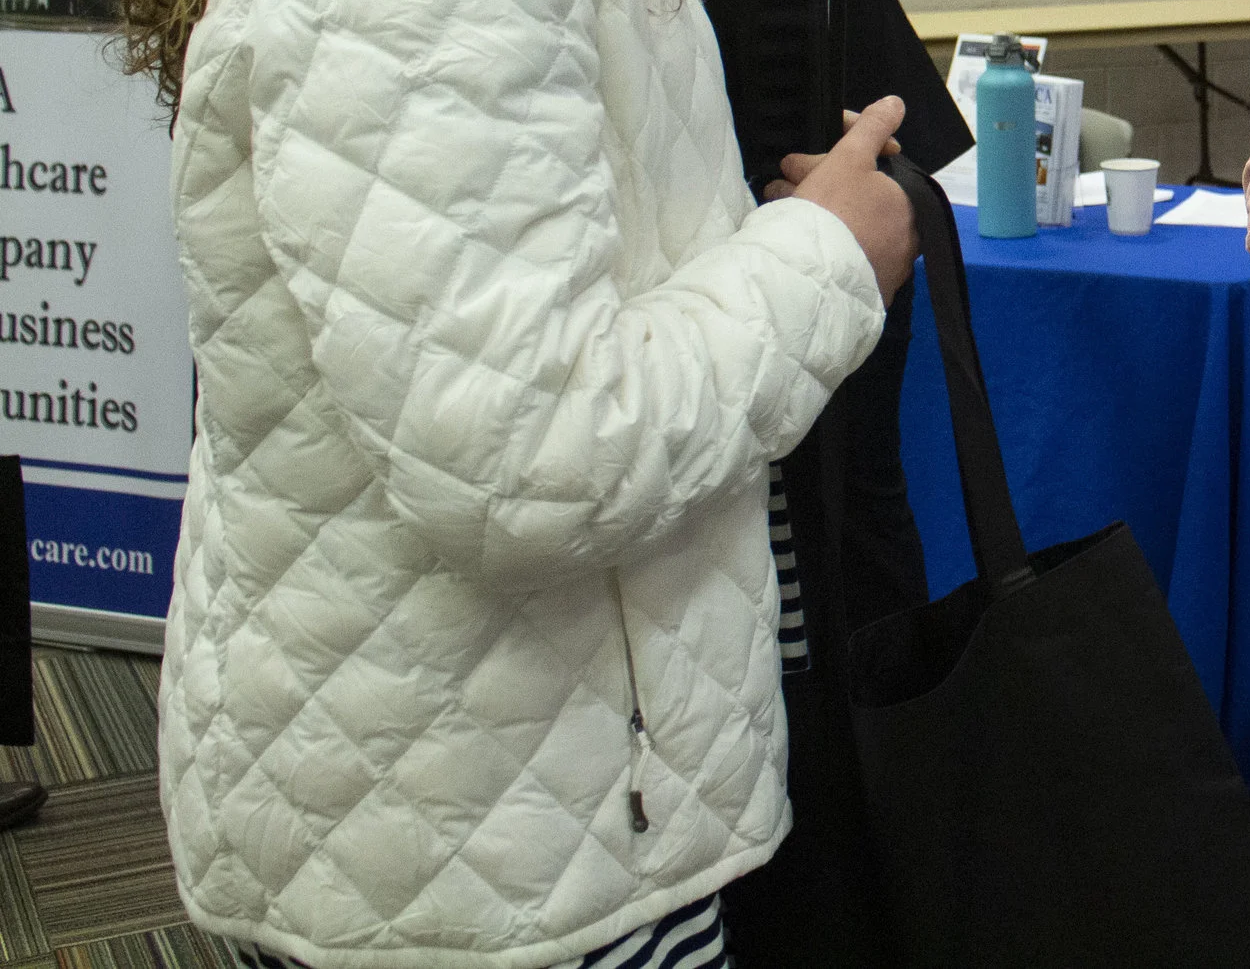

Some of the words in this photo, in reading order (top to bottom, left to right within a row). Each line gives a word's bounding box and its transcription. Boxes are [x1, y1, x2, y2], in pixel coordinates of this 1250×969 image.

[0, 143, 107, 196] hcare
[0, 235, 97, 287] pany
[0, 379, 138, 433] unities
[30, 538, 154, 575] care.com
